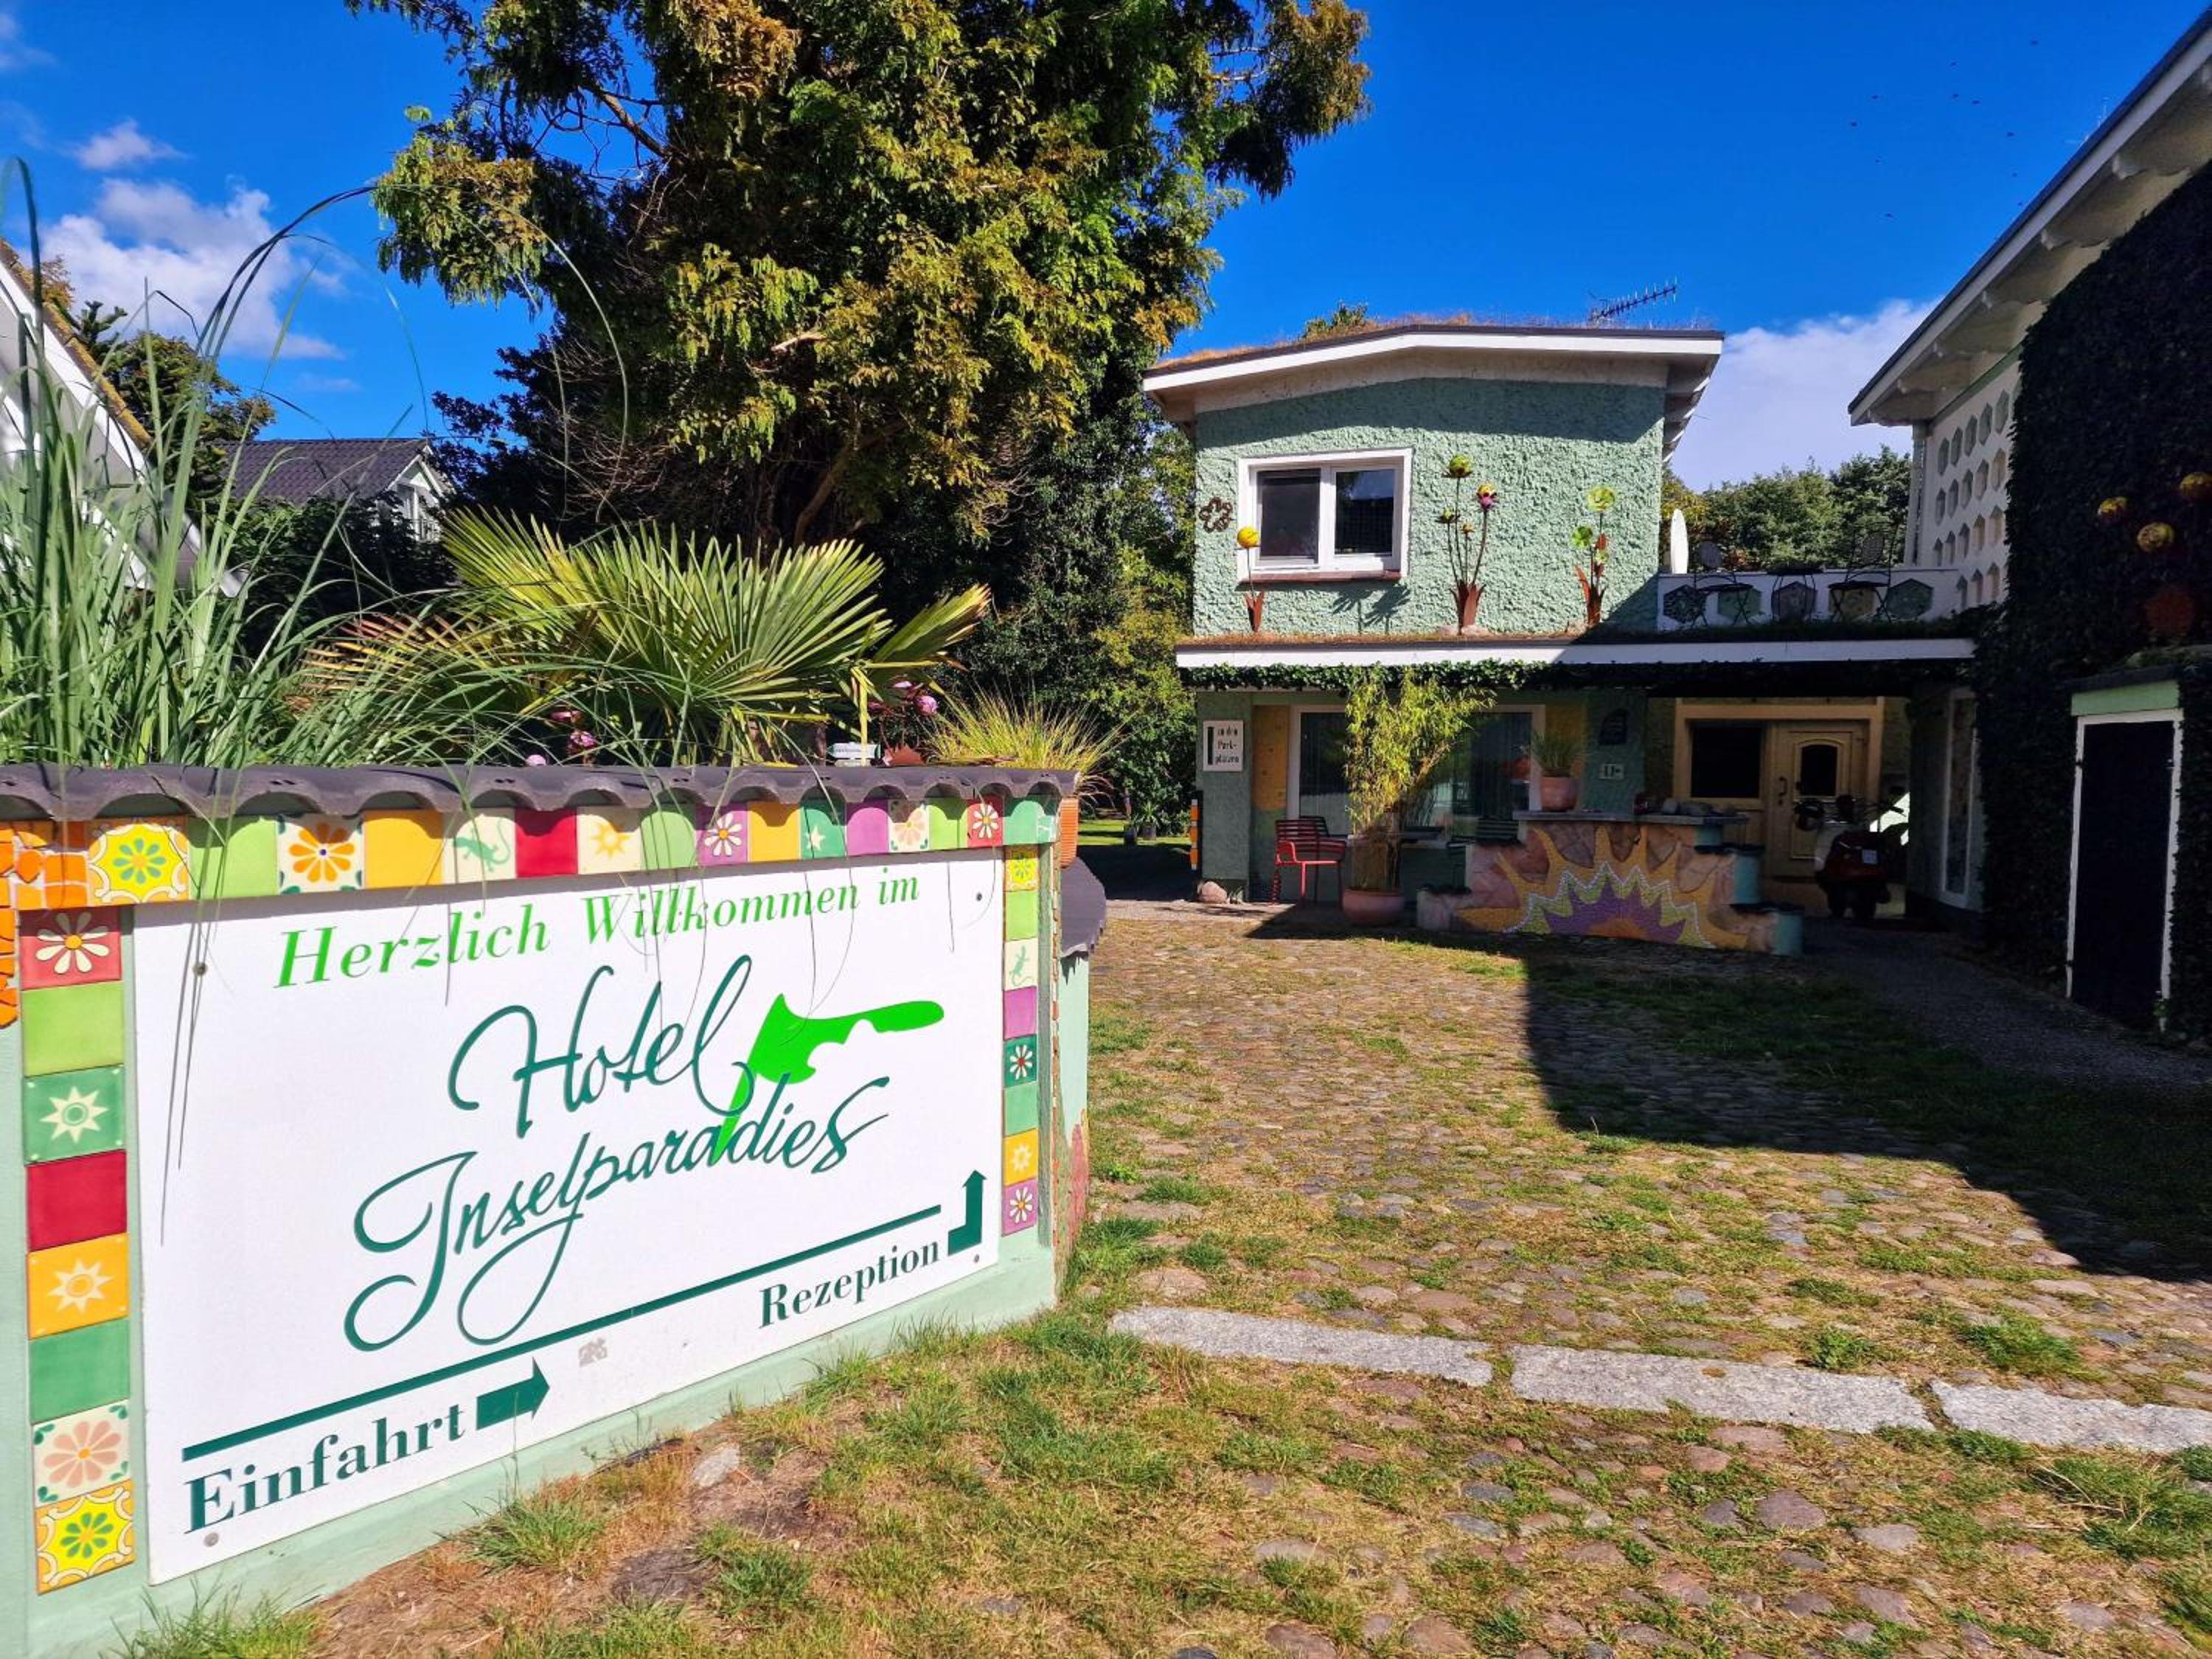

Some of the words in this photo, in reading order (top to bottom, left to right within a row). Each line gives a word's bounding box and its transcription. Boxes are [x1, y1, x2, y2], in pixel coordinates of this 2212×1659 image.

[274, 904, 550, 989] Herzlich
[583, 885, 860, 945] Willkommen
[878, 868, 919, 905] im
[448, 955, 754, 1137] Hotel
[344, 1073, 890, 1351] Inselparadies
[758, 1242, 940, 1329] Rezeption
[184, 1403, 466, 1534] Einfahrt
